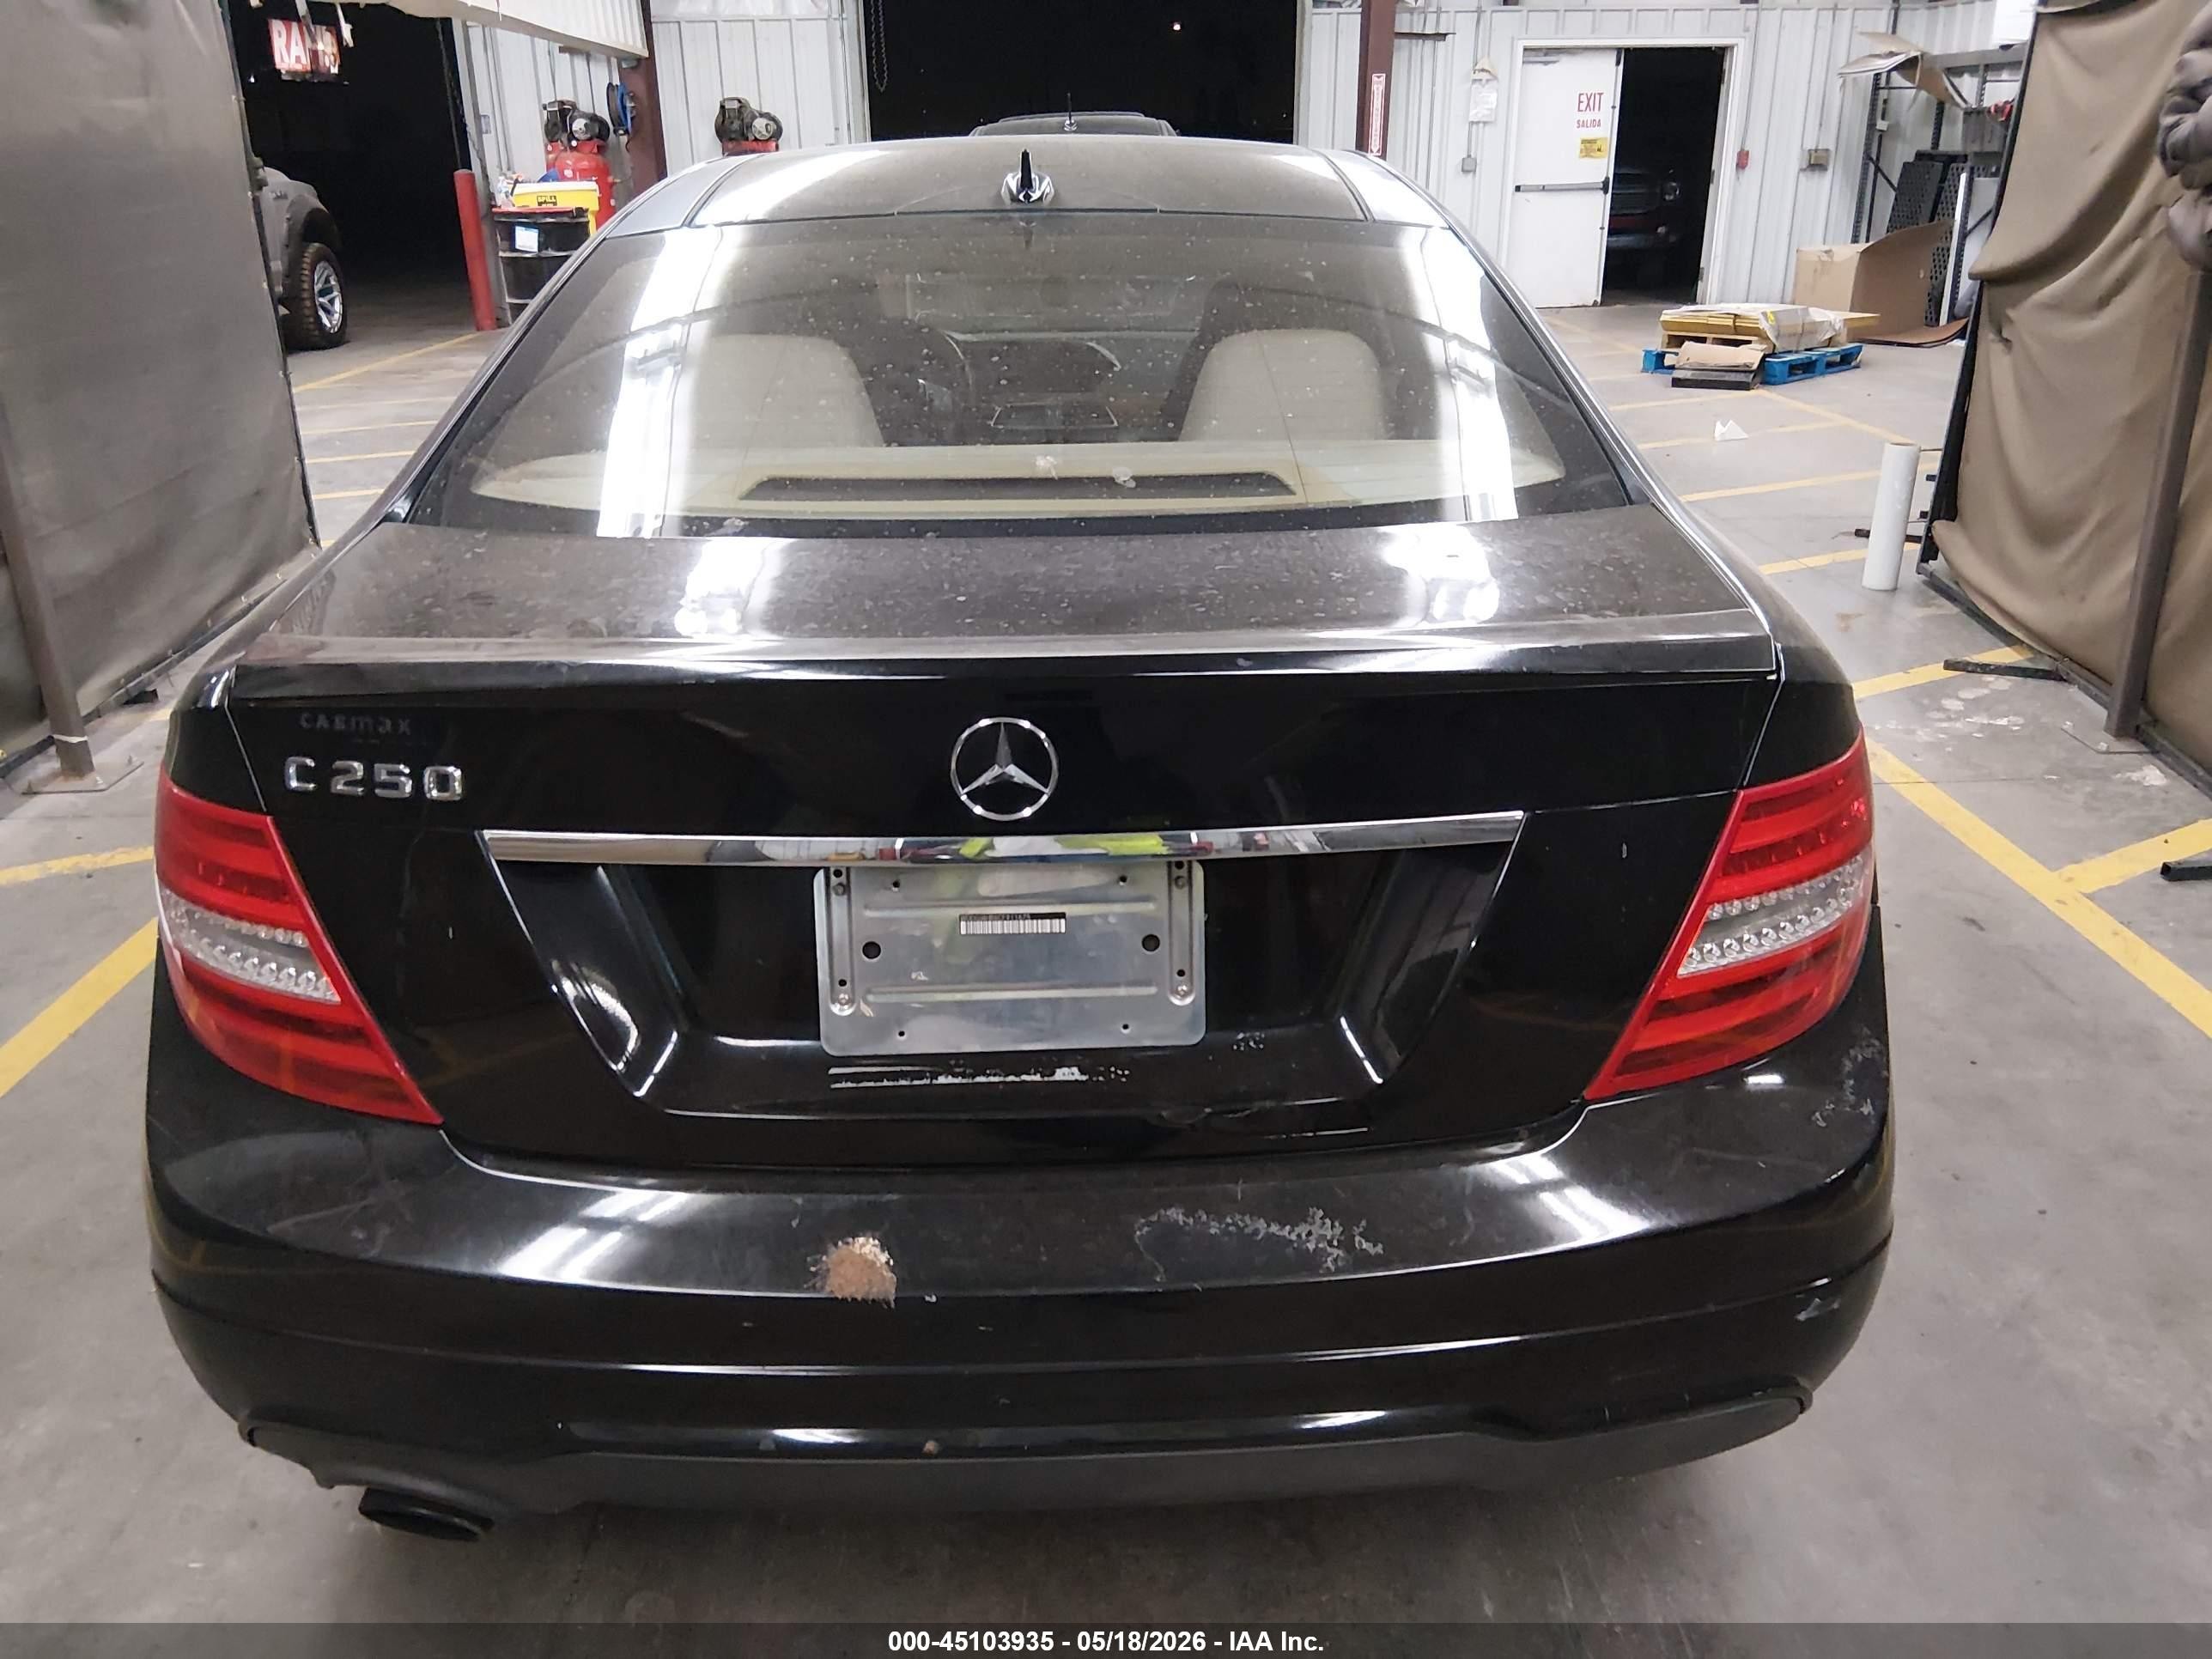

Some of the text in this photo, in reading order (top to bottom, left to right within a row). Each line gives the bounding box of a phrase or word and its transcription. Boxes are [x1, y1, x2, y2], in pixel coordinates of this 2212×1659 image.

[1577, 92, 1604, 112] EXIT
[1577, 118, 1601, 129] SALIDA
[284, 756, 463, 801] C 250
